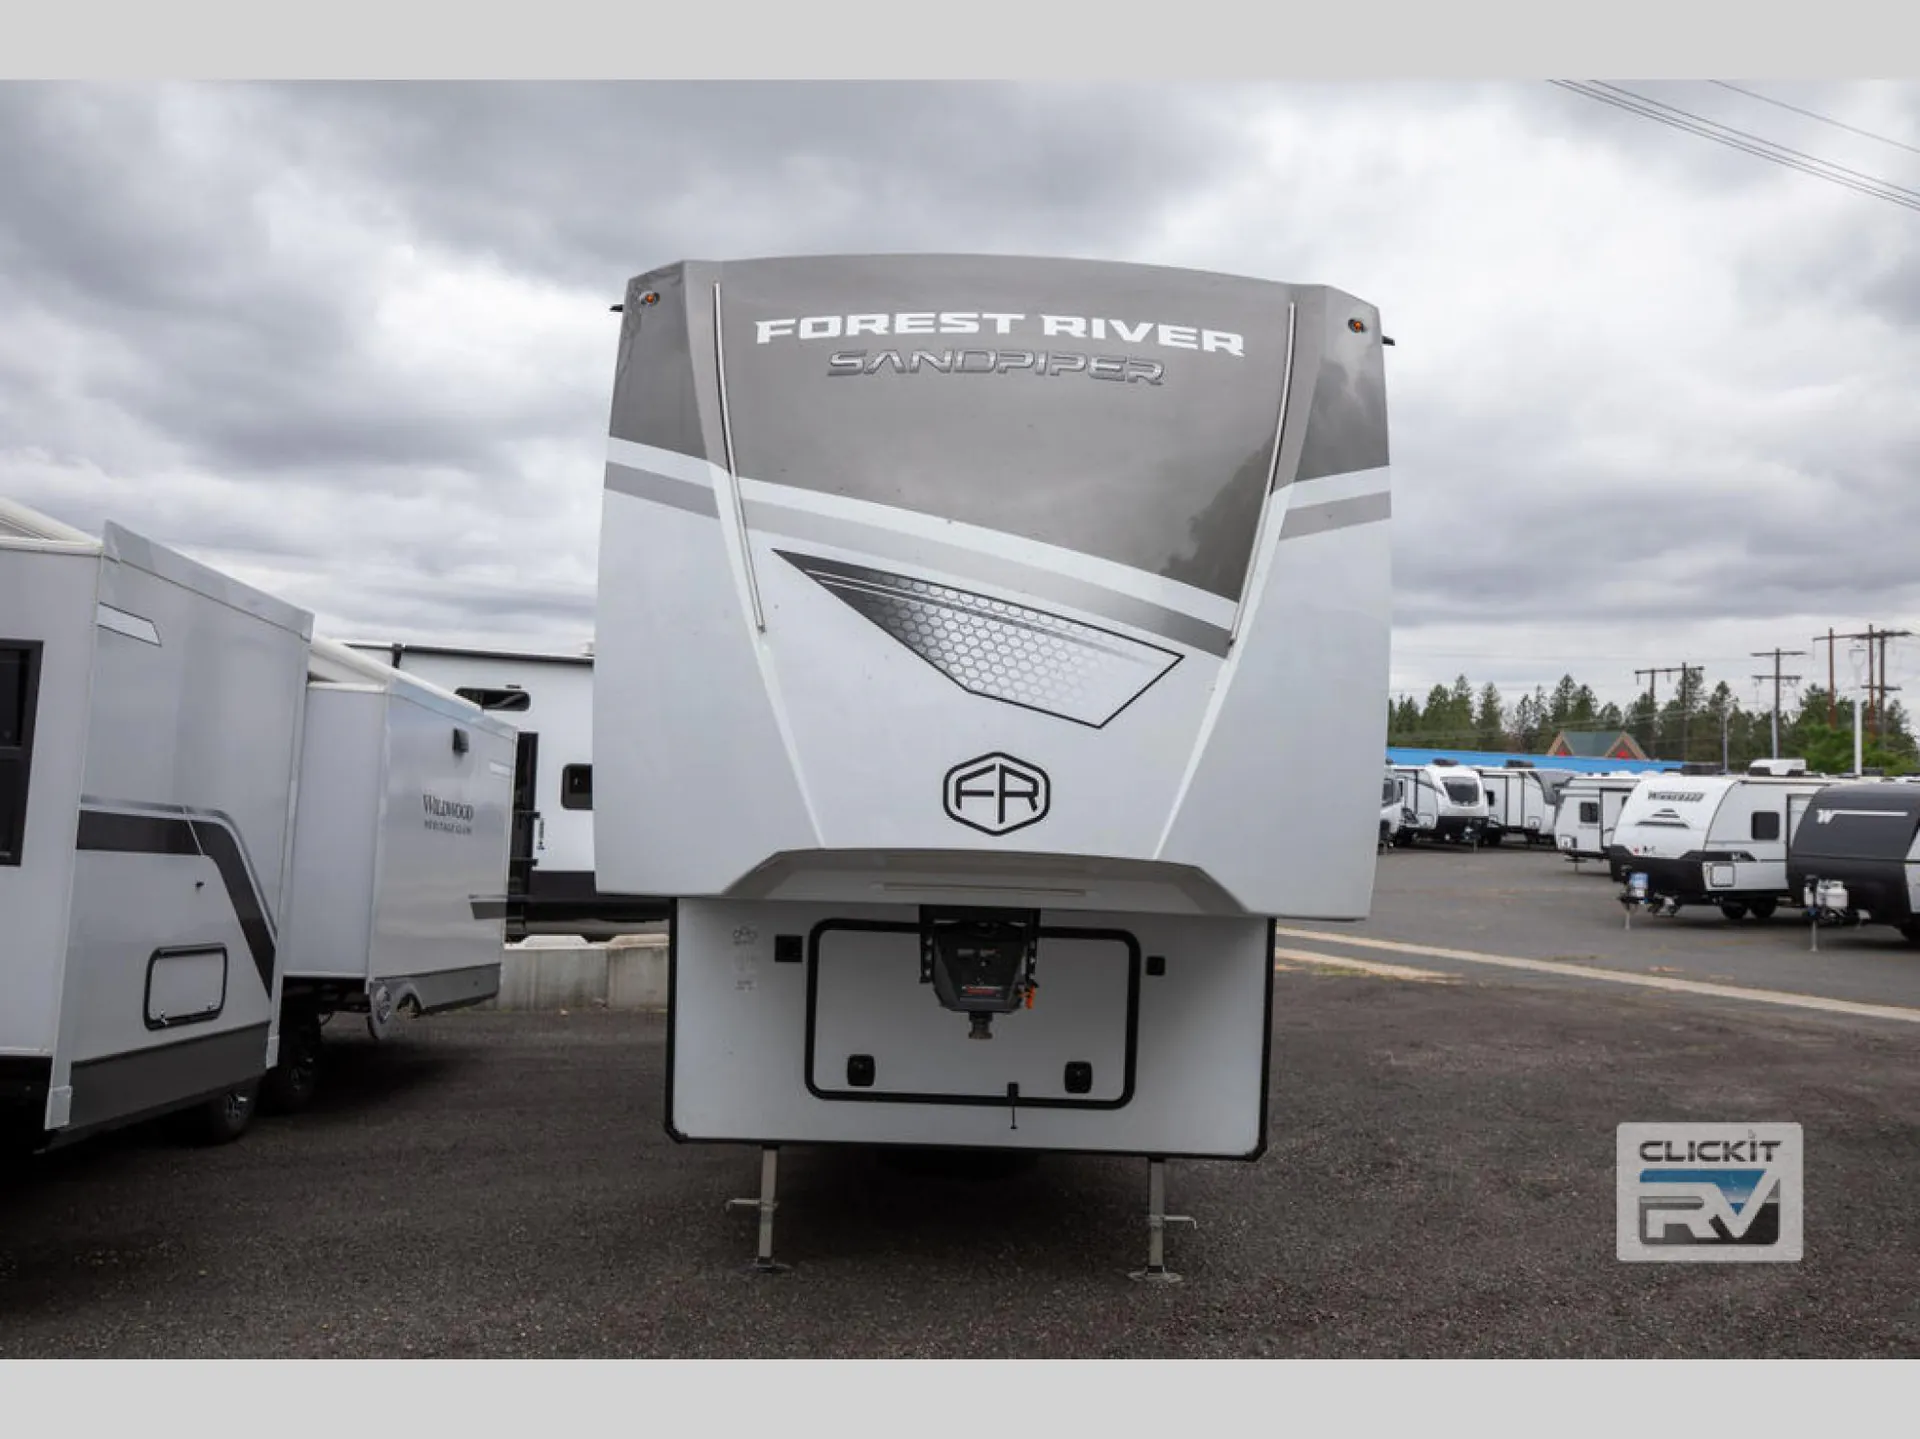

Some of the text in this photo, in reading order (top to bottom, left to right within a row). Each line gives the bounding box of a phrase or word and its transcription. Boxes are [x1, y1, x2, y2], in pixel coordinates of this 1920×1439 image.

[755, 313, 1245, 357] FOREST RIVER
[827, 349, 1164, 386] SANDPIPER
[423, 794, 475, 822] WILDWOOD
[955, 763, 1039, 824] FR
